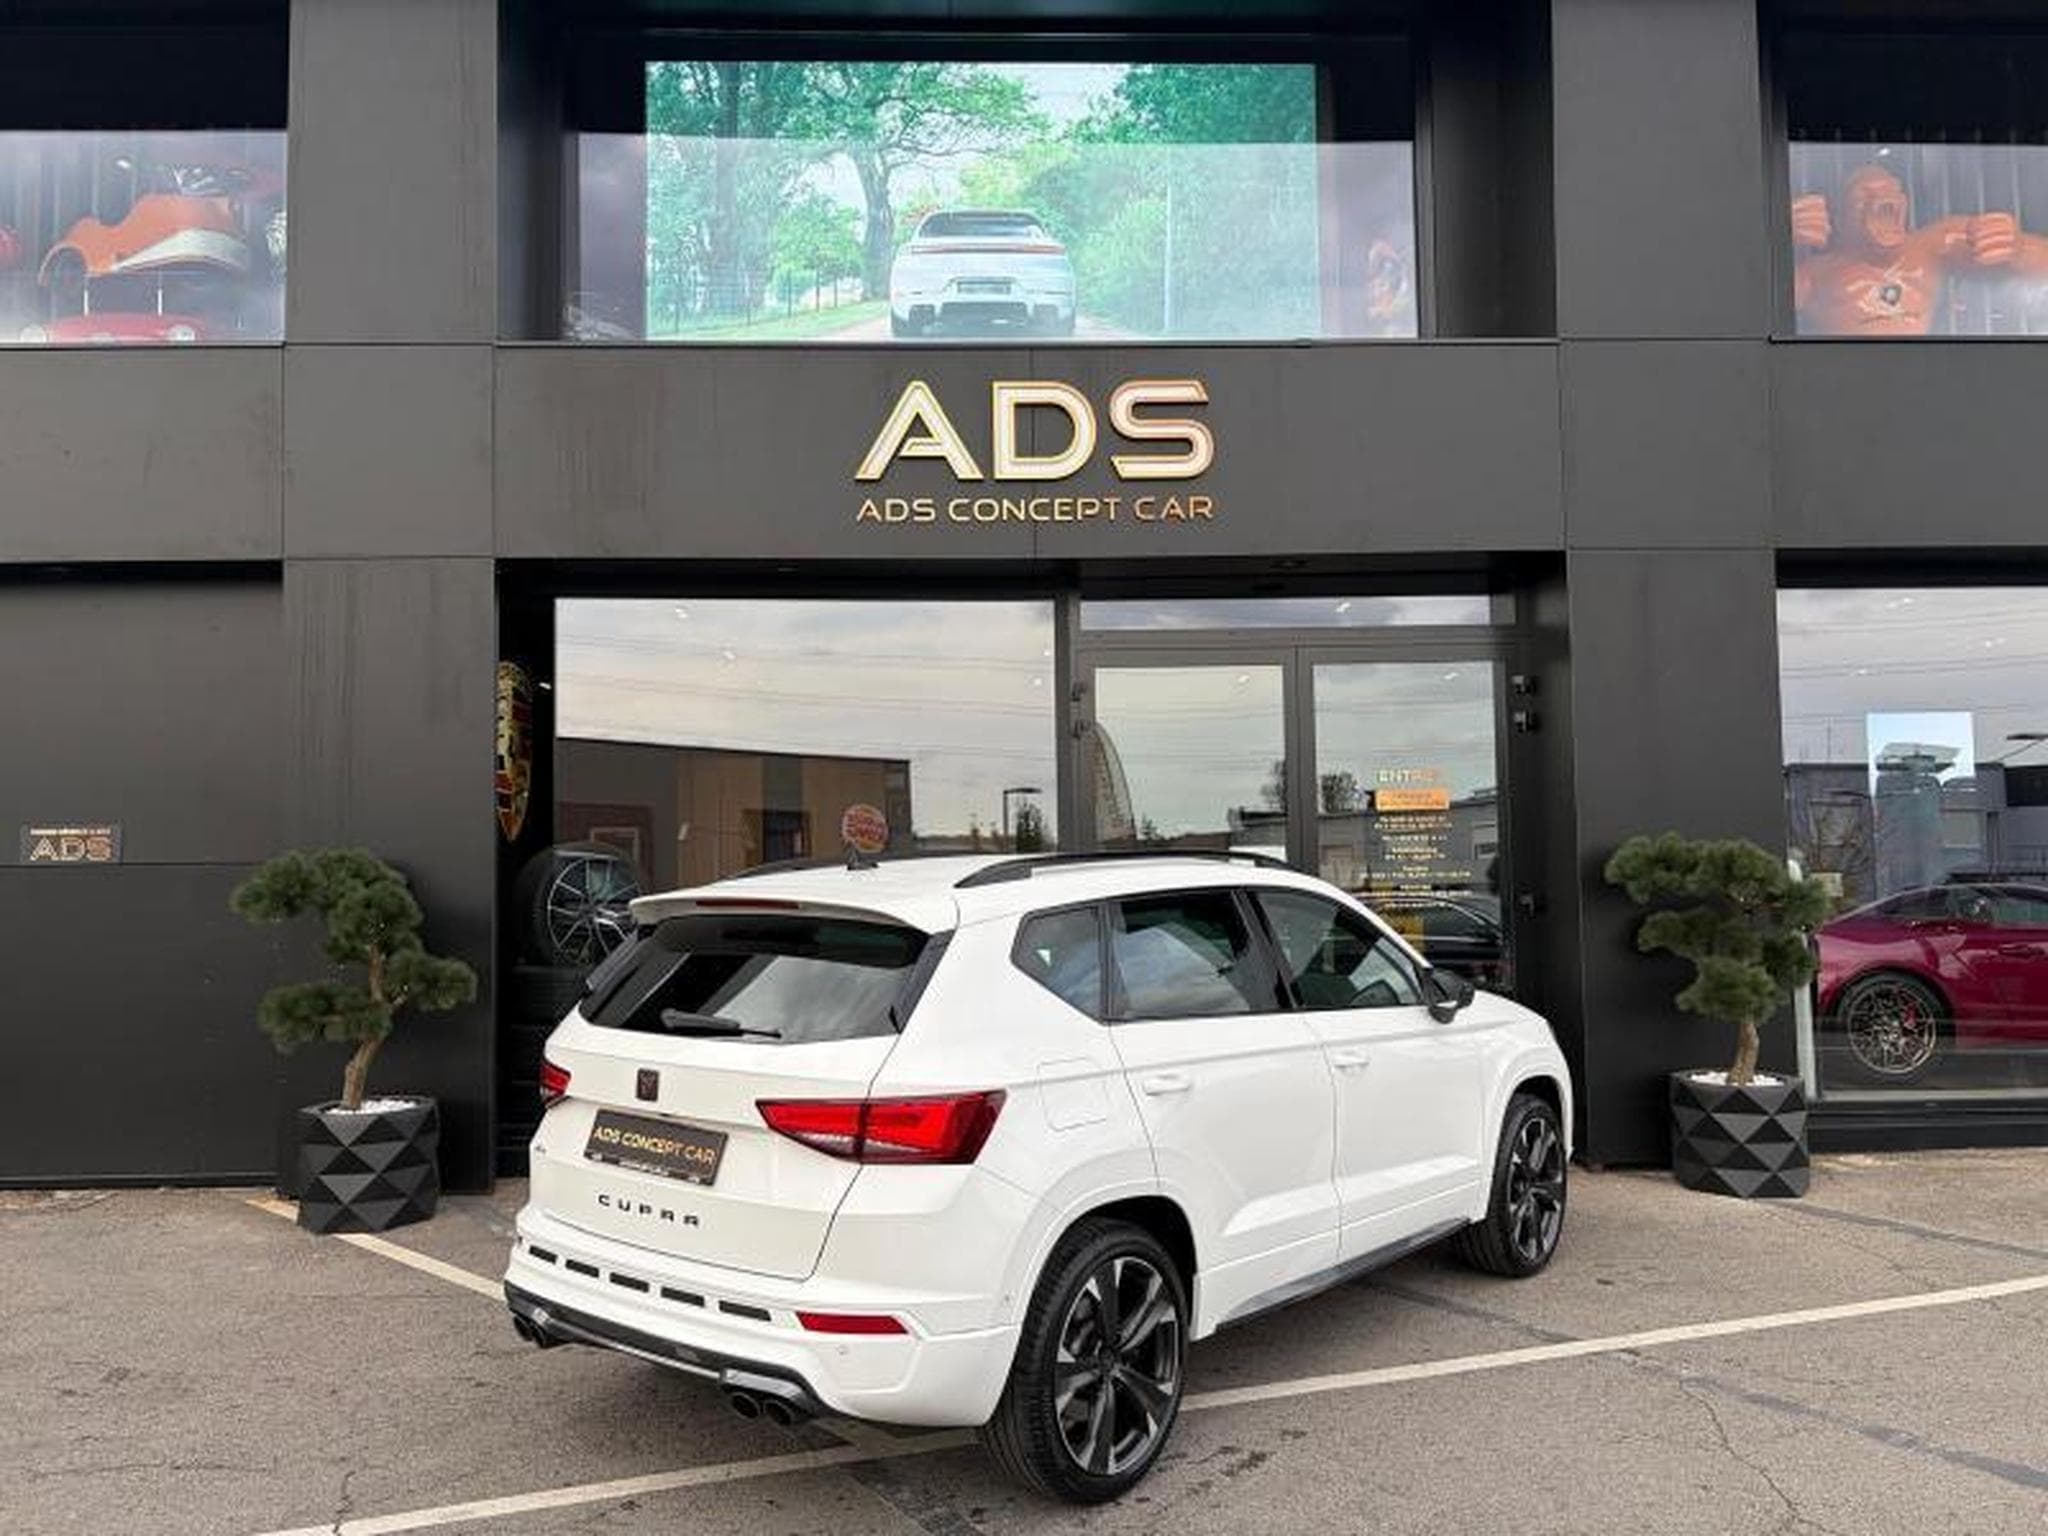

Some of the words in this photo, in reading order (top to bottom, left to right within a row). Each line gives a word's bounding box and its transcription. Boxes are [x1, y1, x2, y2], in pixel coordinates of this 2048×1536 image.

[855, 380, 1214, 480] ADS
[856, 498, 936, 522] ADS
[949, 497, 1121, 522] CONCEPT
[1134, 496, 1214, 520] CAR
[29, 836, 112, 861] ADS
[594, 1127, 621, 1144] ADS
[622, 1132, 685, 1156] CONCEPT
[685, 1146, 715, 1165] CAR
[598, 1194, 699, 1226] CUPRA
